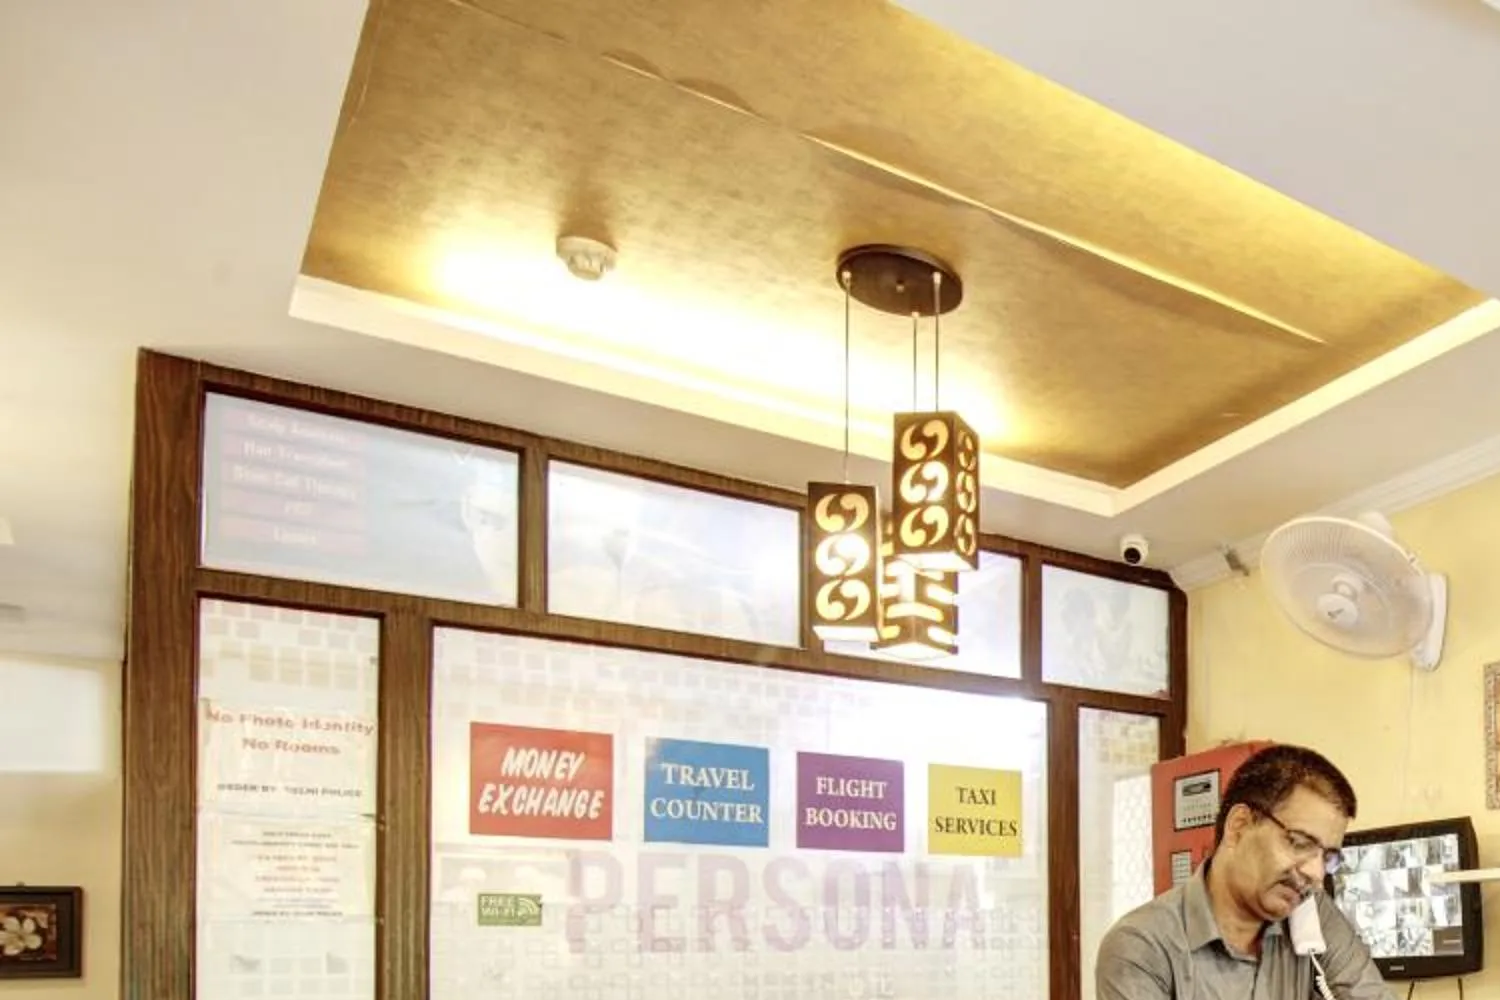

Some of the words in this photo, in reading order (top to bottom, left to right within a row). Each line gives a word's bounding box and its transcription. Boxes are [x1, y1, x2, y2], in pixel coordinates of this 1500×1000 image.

[242, 738, 269, 751] No
[501, 747, 585, 782] MONEY
[660, 762, 755, 791] TRAVEL
[816, 776, 887, 799] FLIGHT
[956, 786, 997, 806] TAXI
[478, 783, 605, 820] EXCHANGE
[650, 797, 765, 824] COUNTER
[805, 807, 897, 831] BOOKING
[935, 816, 1018, 838] SERVICES
[481, 895, 515, 906] FREE
[565, 852, 987, 953] PERSONA
